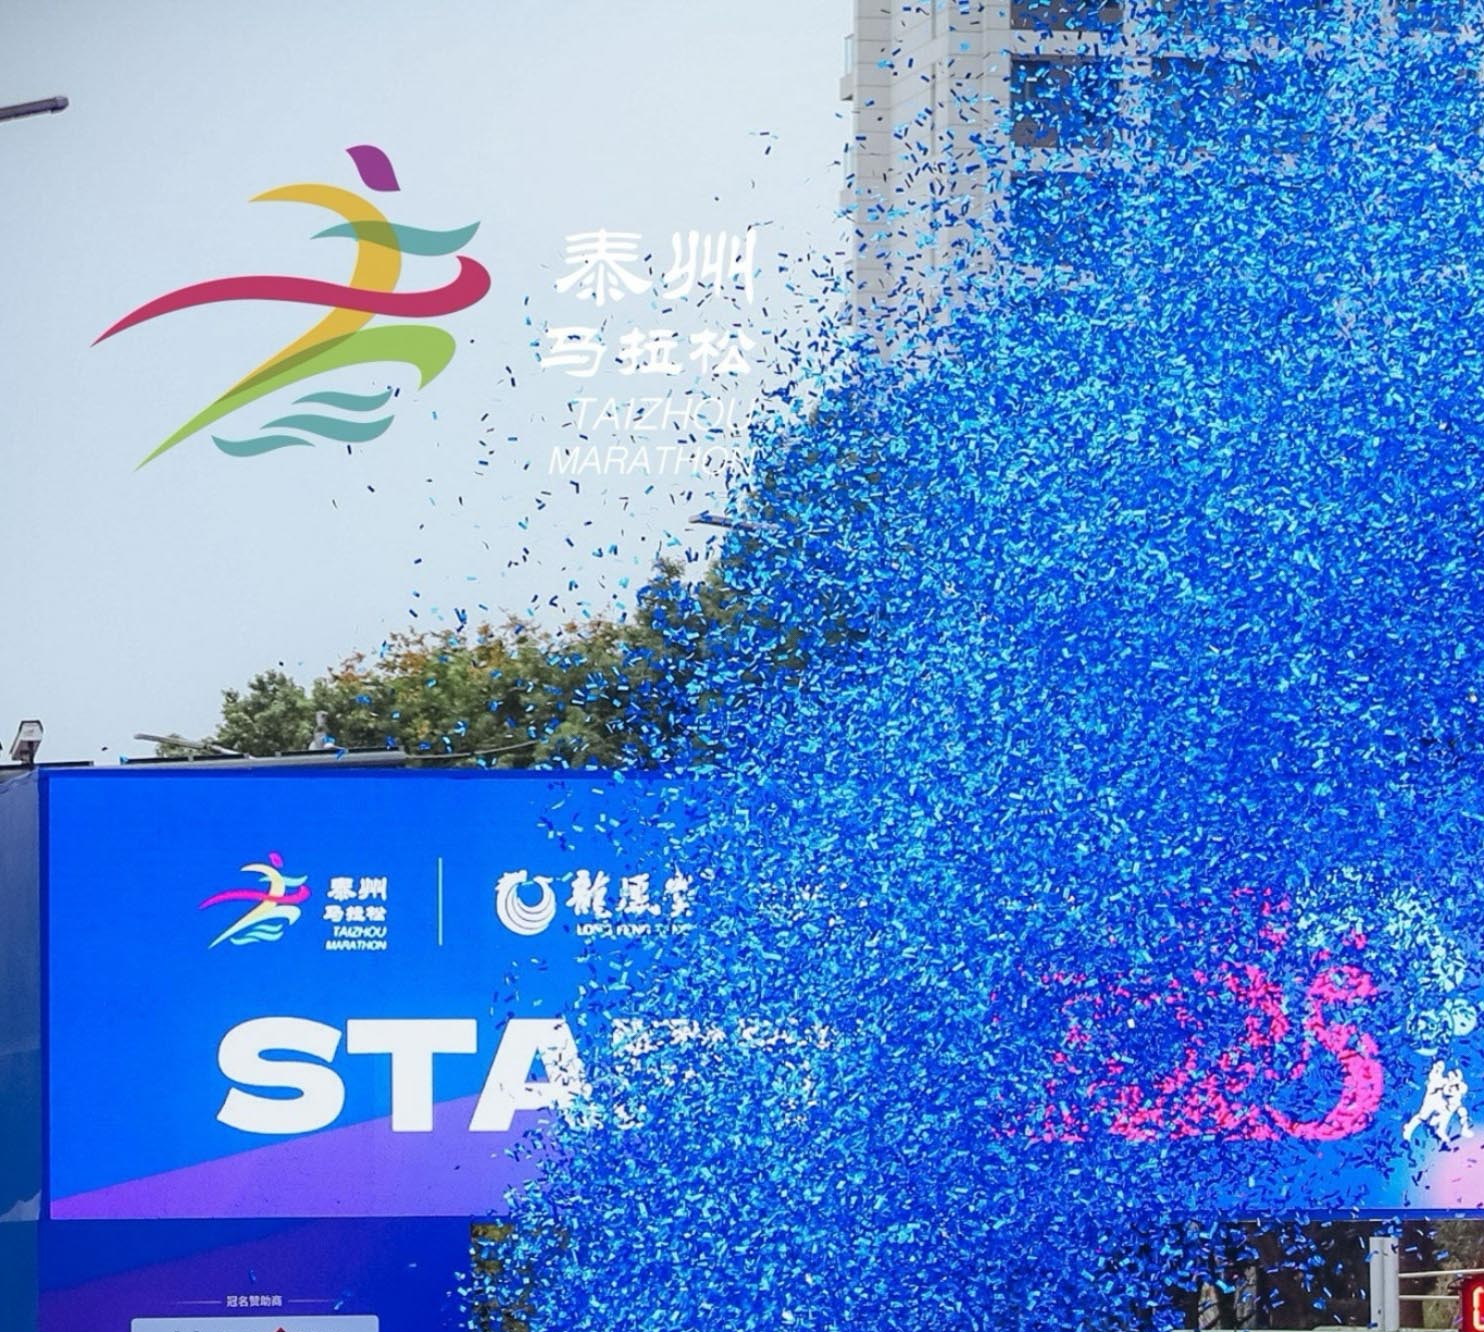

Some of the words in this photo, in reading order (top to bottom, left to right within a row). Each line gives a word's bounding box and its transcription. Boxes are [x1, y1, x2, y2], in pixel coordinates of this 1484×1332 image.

[327, 876, 388, 901] 泰州
[323, 905, 387, 923] 马拉松
[333, 925, 387, 939] TAIZHOU
[325, 940, 387, 952] MARATHON
